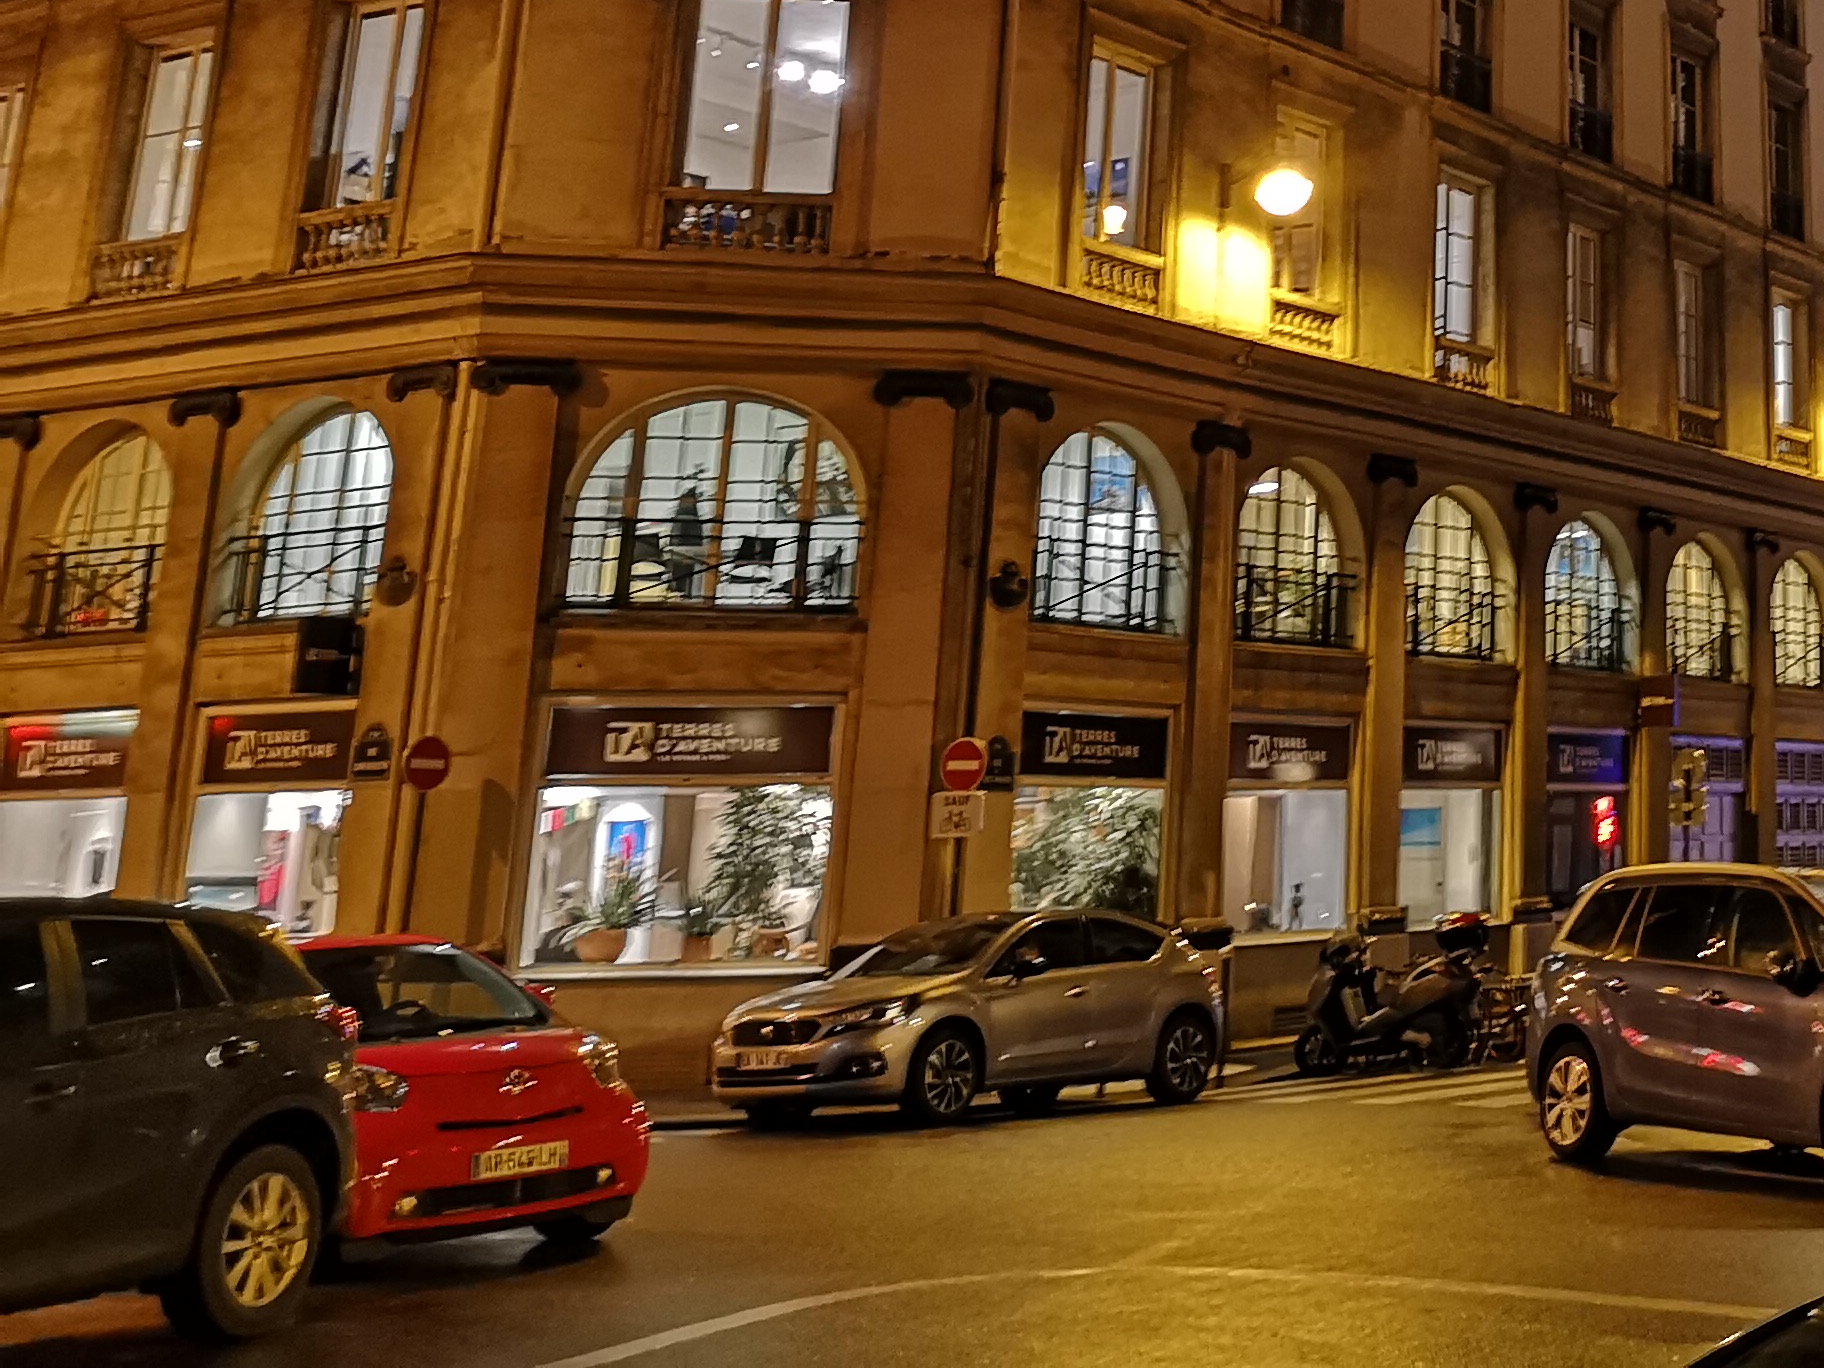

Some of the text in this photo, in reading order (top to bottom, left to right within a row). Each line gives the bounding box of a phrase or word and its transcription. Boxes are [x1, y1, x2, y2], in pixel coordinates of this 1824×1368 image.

[258, 729, 311, 744] TERRES
[656, 723, 736, 738] TERRES
[1072, 728, 1117, 743] TERRES
[653, 737, 783, 753] D'AVENTURE
[1271, 736, 1309, 750] TERRES
[256, 742, 339, 760] D'AVENTURE
[1071, 743, 1142, 759] D'AVENTURE
[944, 795, 970, 806] SAUF
